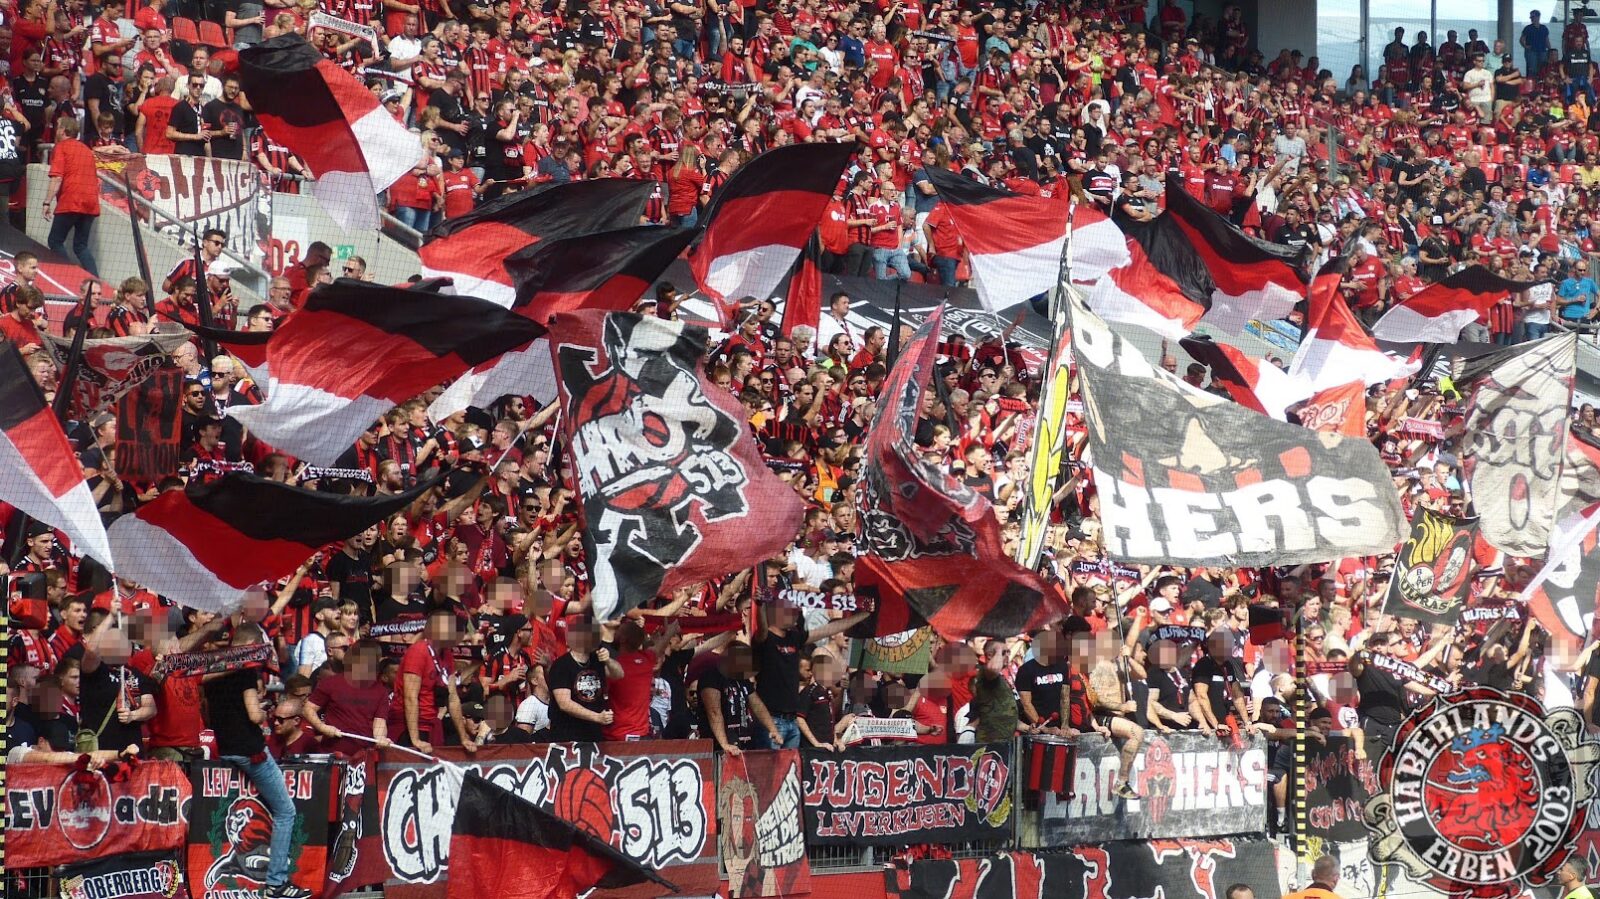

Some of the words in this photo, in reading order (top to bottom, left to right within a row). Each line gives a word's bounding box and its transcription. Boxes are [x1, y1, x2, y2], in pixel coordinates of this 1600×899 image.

[679, 450, 744, 494] 513
[831, 594, 857, 611] 513
[1373, 653, 1426, 683] ULTRAS
[803, 755, 976, 808] JUGEND
[615, 757, 706, 870] 513
[816, 803, 966, 838] LEVERKUSEN
[83, 868, 163, 899] OBERBERG
